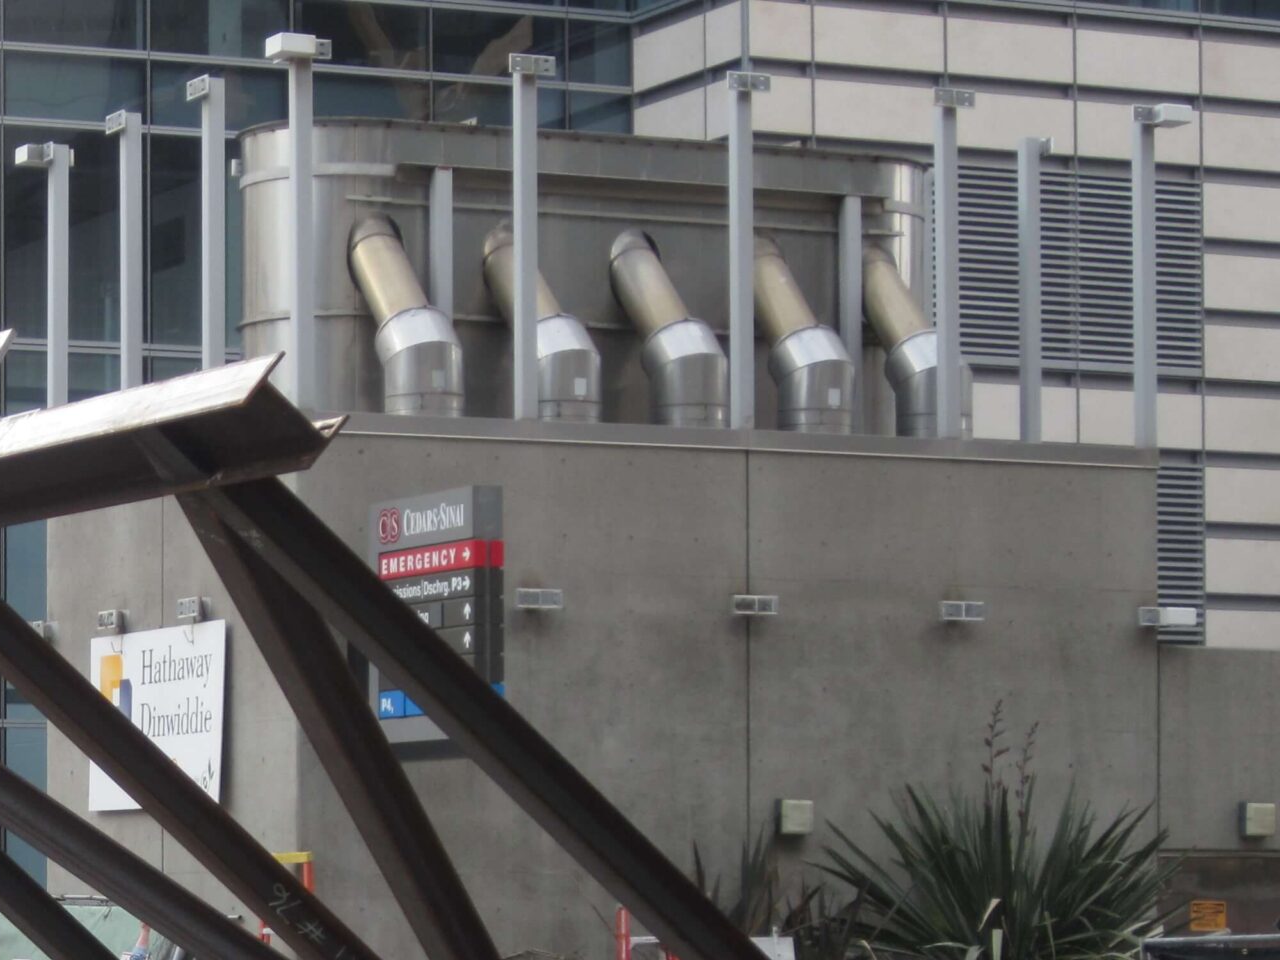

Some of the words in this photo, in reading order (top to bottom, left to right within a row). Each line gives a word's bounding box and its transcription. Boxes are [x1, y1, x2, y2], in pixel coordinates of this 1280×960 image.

[381, 547, 457, 575] EMERGENCY
[451, 576, 462, 592] P3
[141, 645, 213, 689] Hathaway
[140, 696, 213, 738] Dinwiddie
